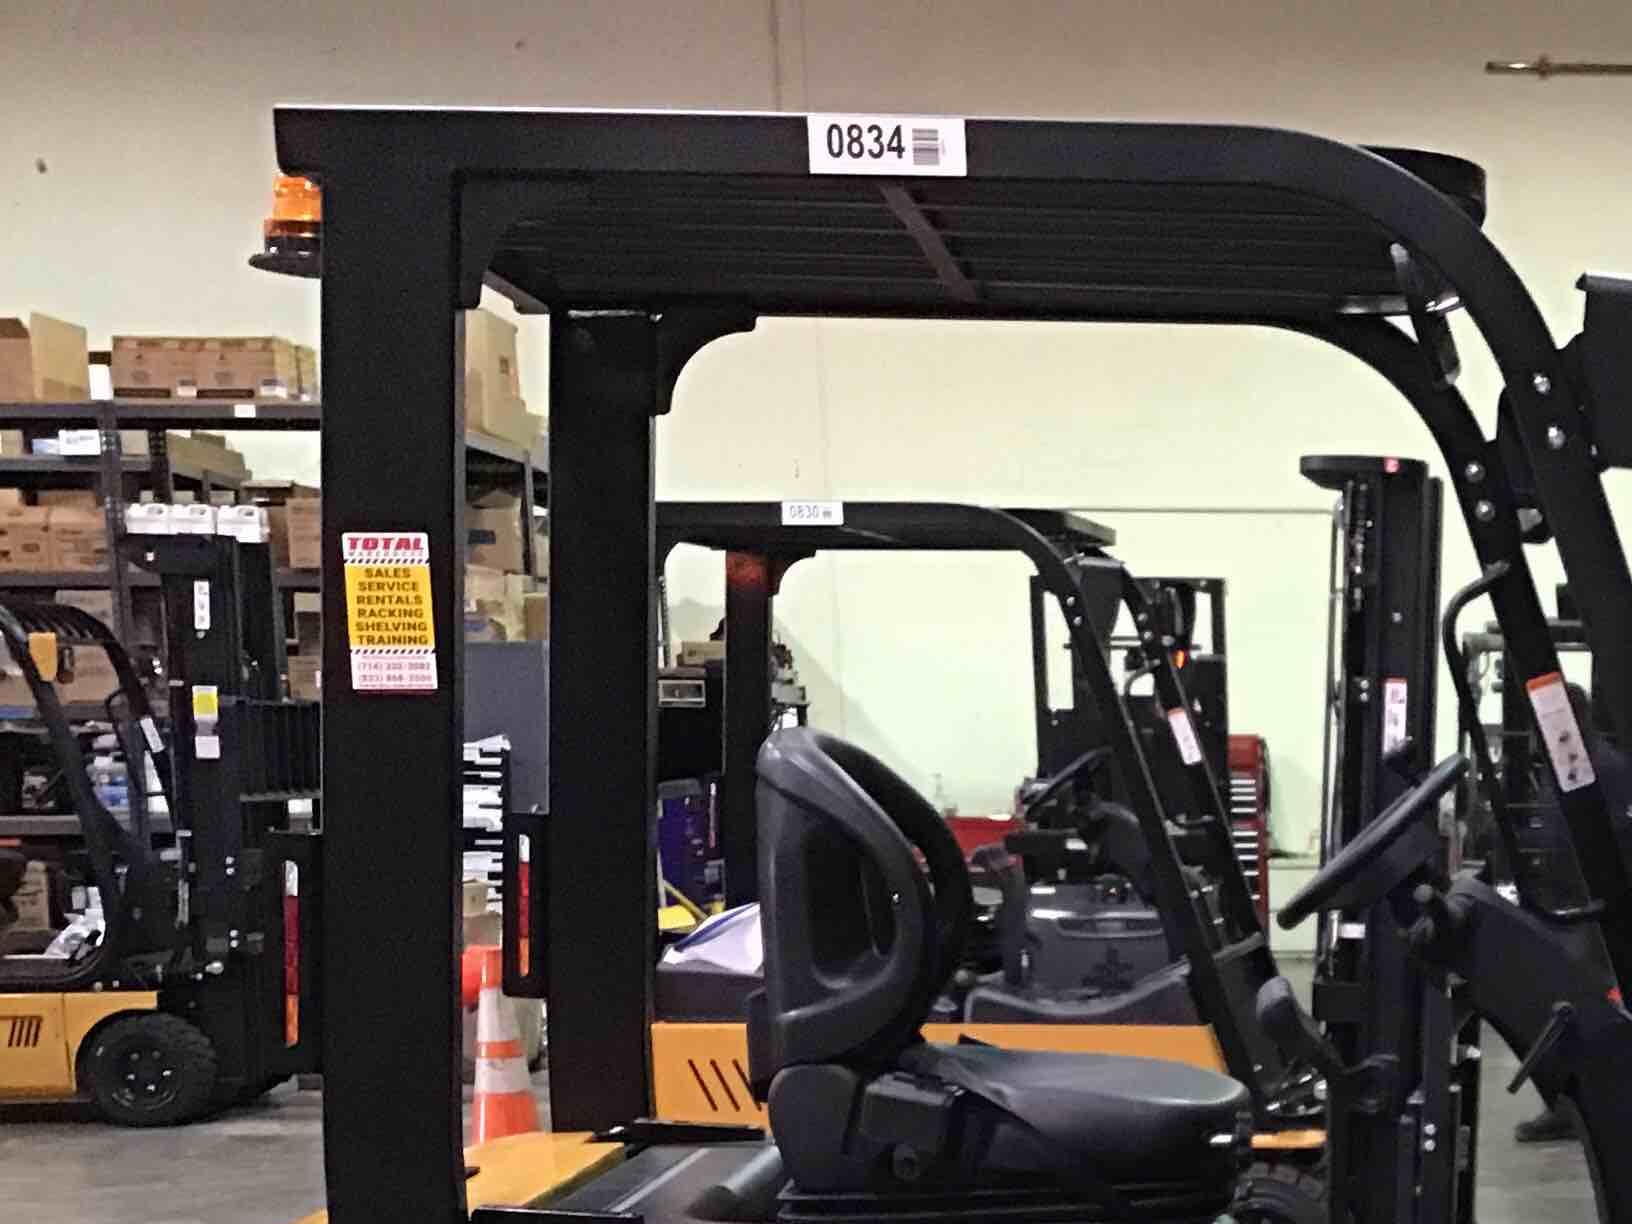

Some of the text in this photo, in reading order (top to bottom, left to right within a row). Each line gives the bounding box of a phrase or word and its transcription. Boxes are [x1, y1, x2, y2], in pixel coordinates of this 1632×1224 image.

[826, 123, 906, 159] 0834
[347, 537, 424, 550] TOTAL
[364, 567, 411, 578] SALES
[357, 581, 419, 592] SERVICE
[356, 595, 423, 605] RENTALS
[357, 608, 424, 618] RACKING
[355, 621, 428, 631] SHELVING
[356, 635, 429, 645] TRAINING
